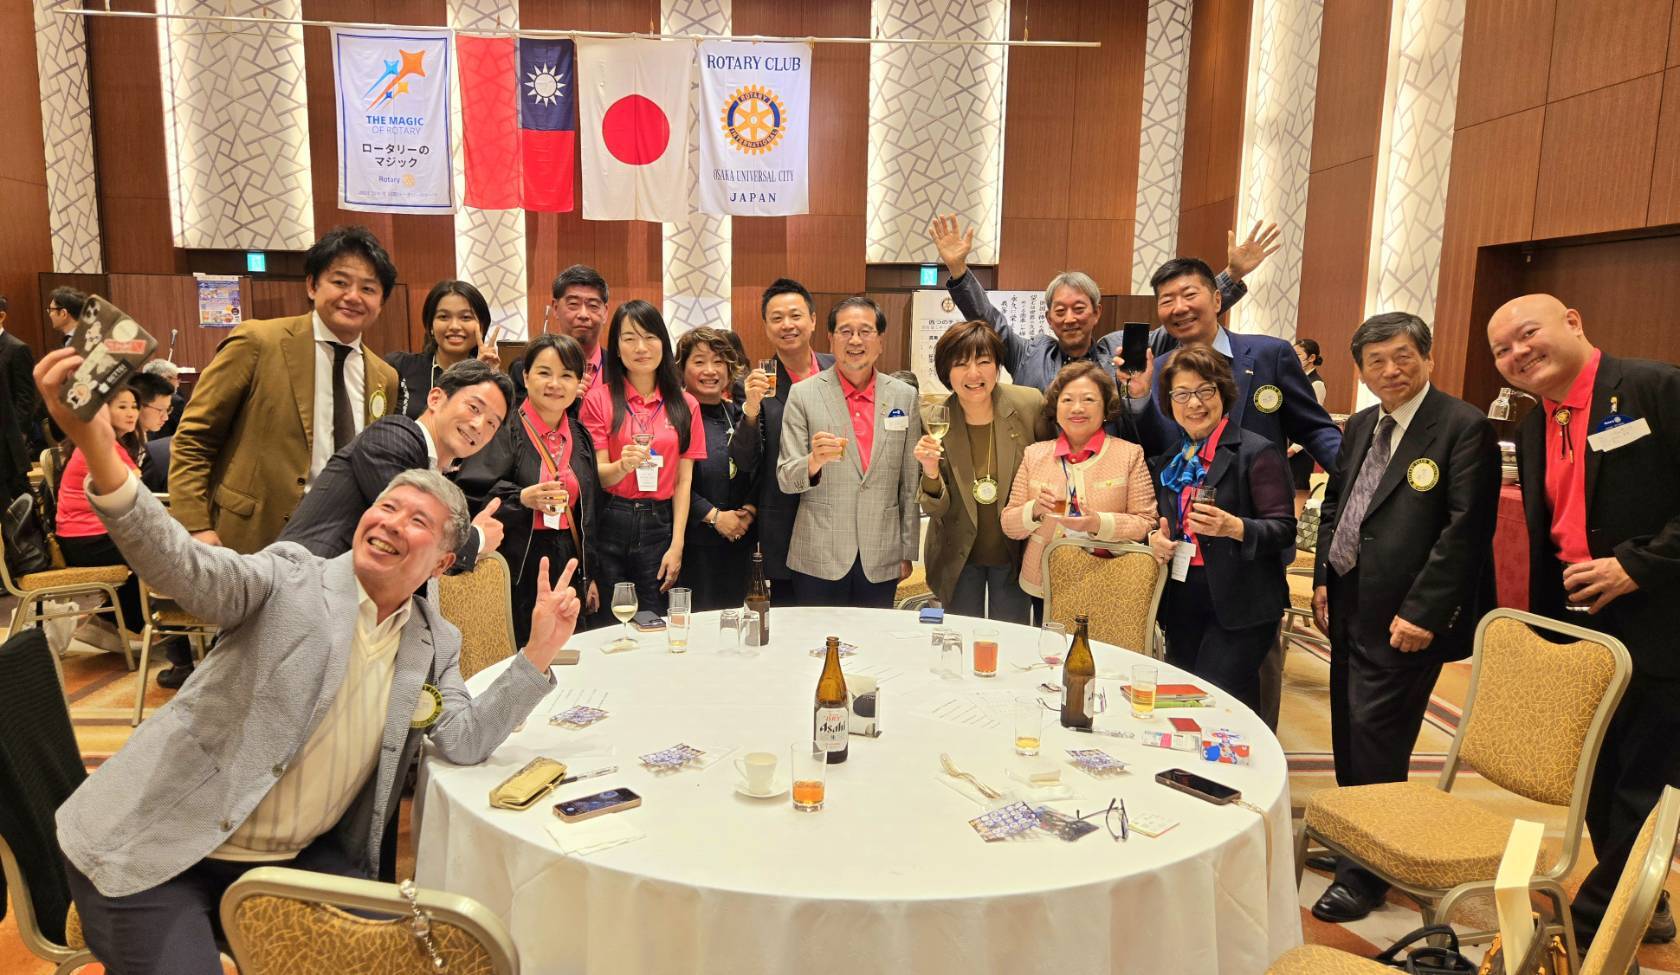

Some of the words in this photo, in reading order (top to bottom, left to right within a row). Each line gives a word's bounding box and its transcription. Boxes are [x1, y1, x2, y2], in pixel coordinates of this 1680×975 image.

[707, 54, 762, 71] ROTARY
[764, 57, 801, 72] CLUB
[366, 115, 386, 125] THE
[389, 116, 424, 127] MAGIC
[372, 125, 385, 134] OF
[386, 125, 421, 136] ROTARY
[362, 143, 430, 156] ロータリーの
[375, 157, 418, 168] マジック
[378, 175, 400, 185] Rotary
[713, 169, 736, 181] OSAKA
[736, 169, 777, 183] UNIVERSAL
[778, 169, 794, 182] CITY
[729, 192, 777, 203] JAPAN
[819, 720, 846, 733] Asahi
